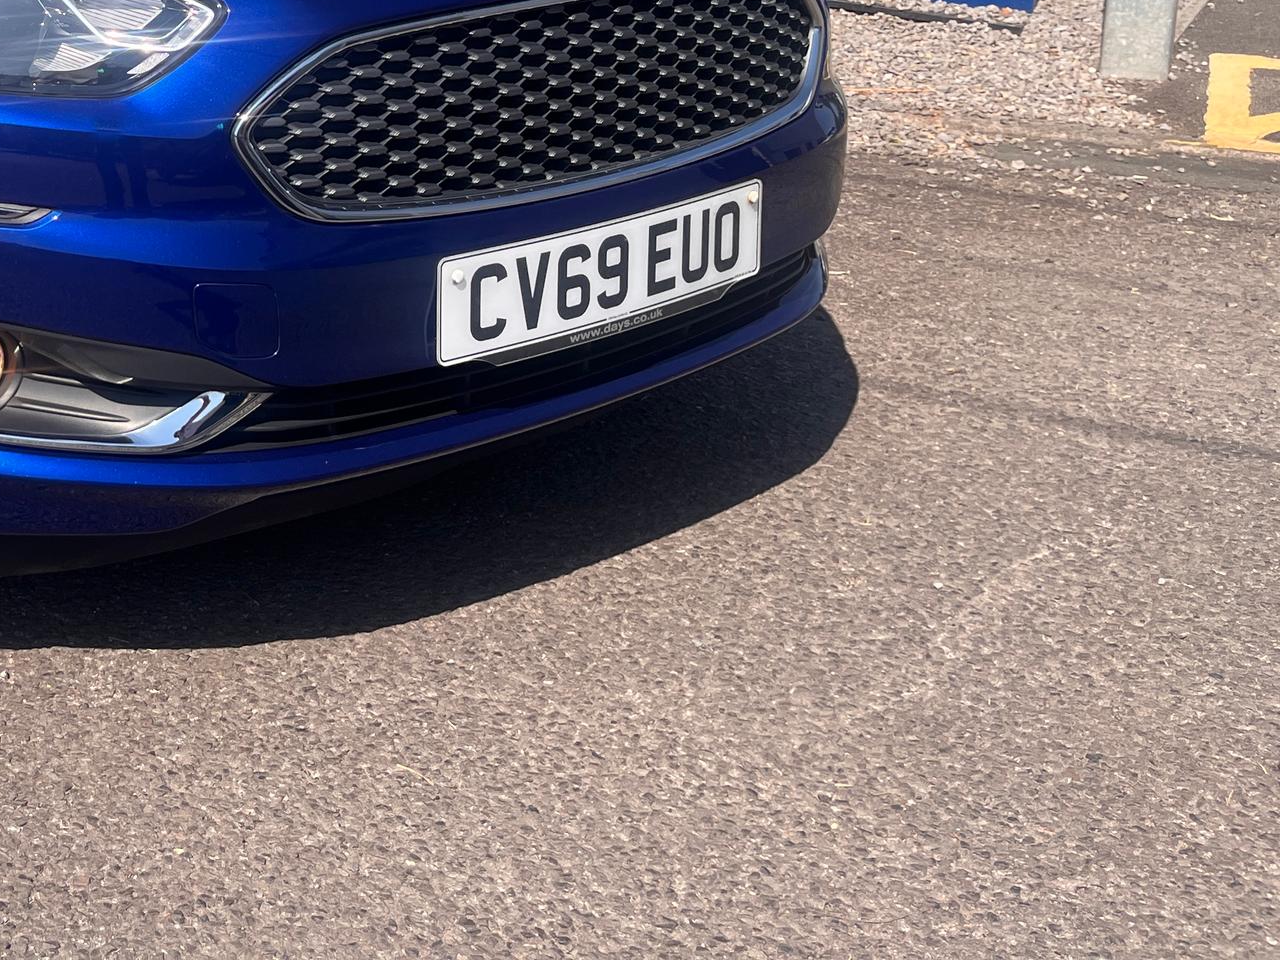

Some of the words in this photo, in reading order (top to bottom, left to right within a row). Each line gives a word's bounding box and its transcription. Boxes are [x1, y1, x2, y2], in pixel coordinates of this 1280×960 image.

[470, 234, 629, 341] CV69
[647, 200, 741, 297] EUO
[570, 309, 663, 343] www.days.co.uk
